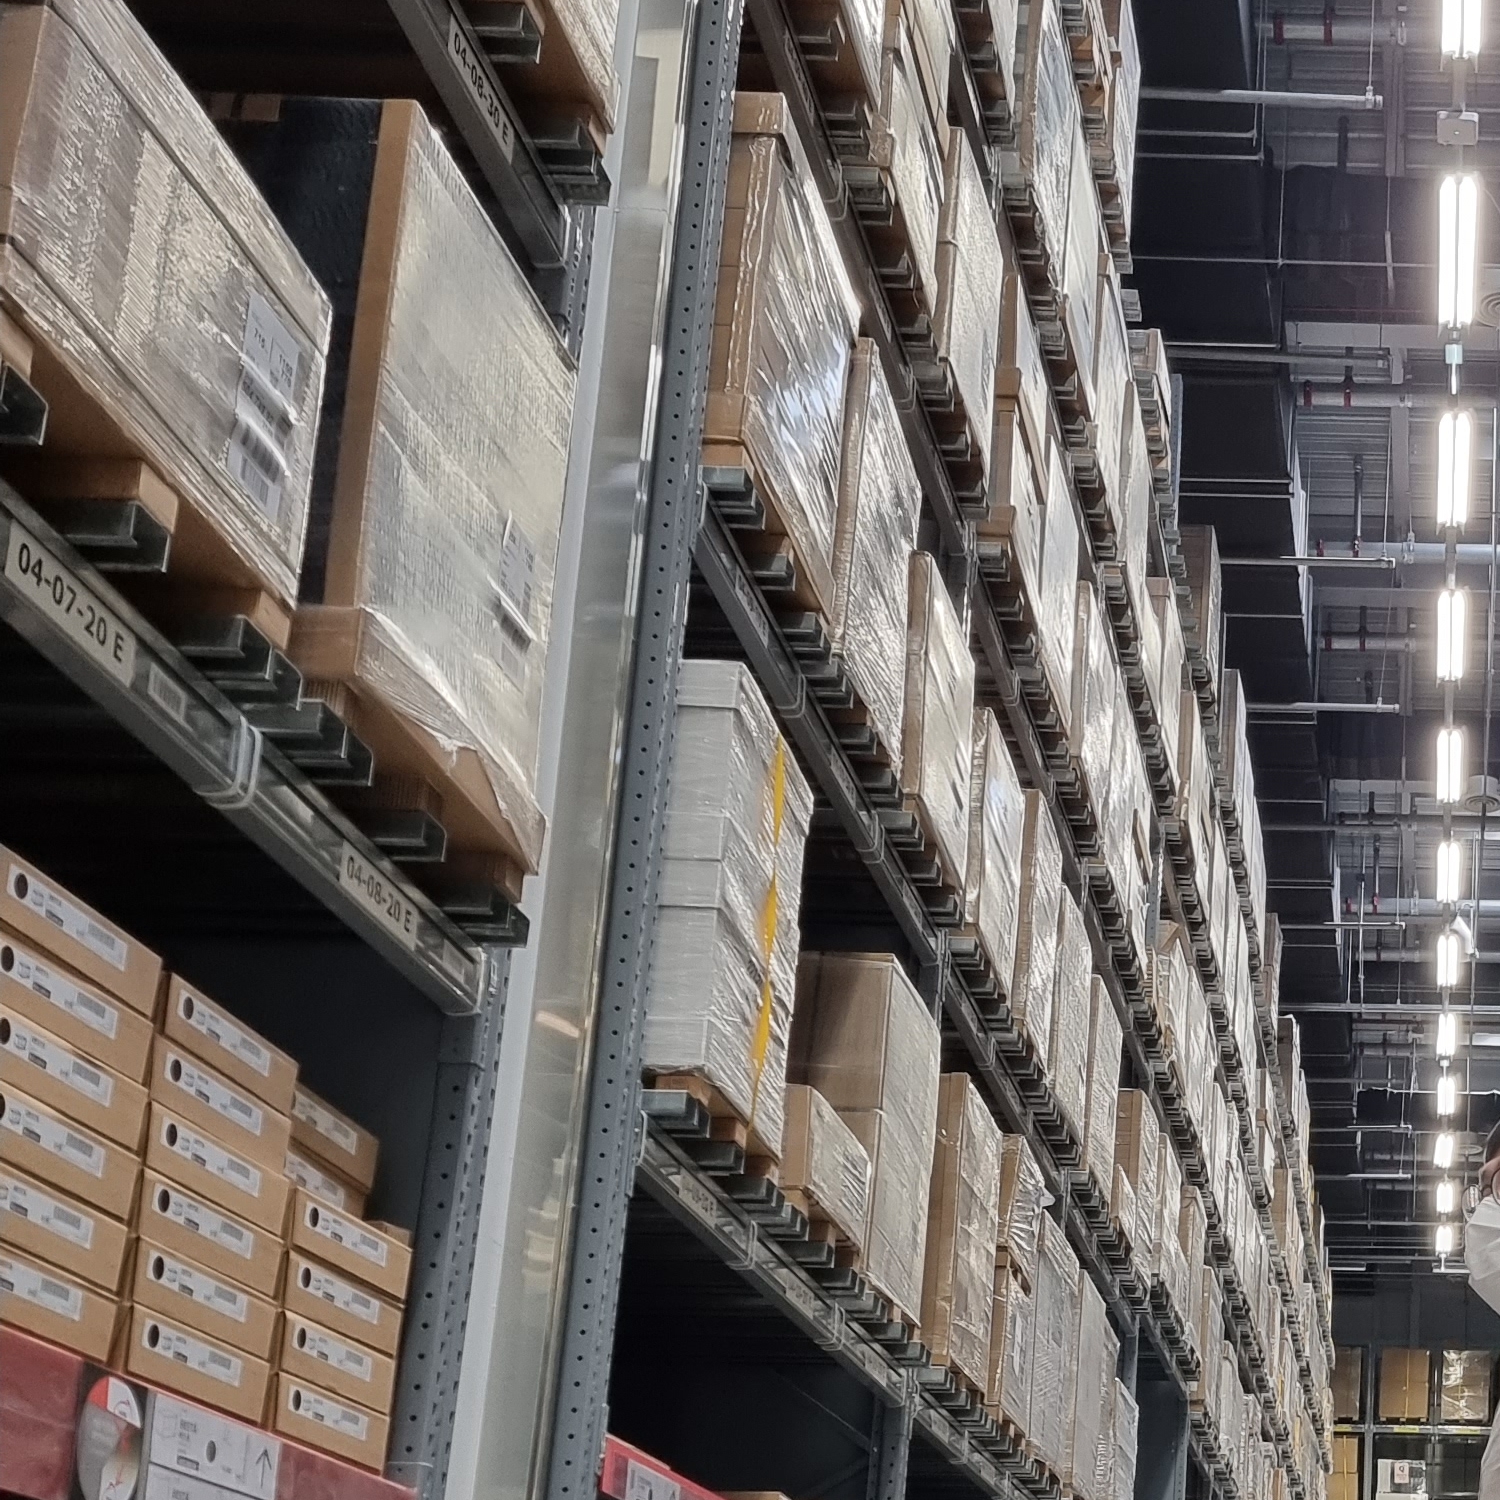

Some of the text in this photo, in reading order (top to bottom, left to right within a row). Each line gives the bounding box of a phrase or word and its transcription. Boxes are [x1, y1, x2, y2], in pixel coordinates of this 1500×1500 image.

[454, 32, 509, 145] 04-08-30 E
[18, 542, 124, 663] 04-07-20 E
[346, 854, 412, 933] 04-08-20 E
